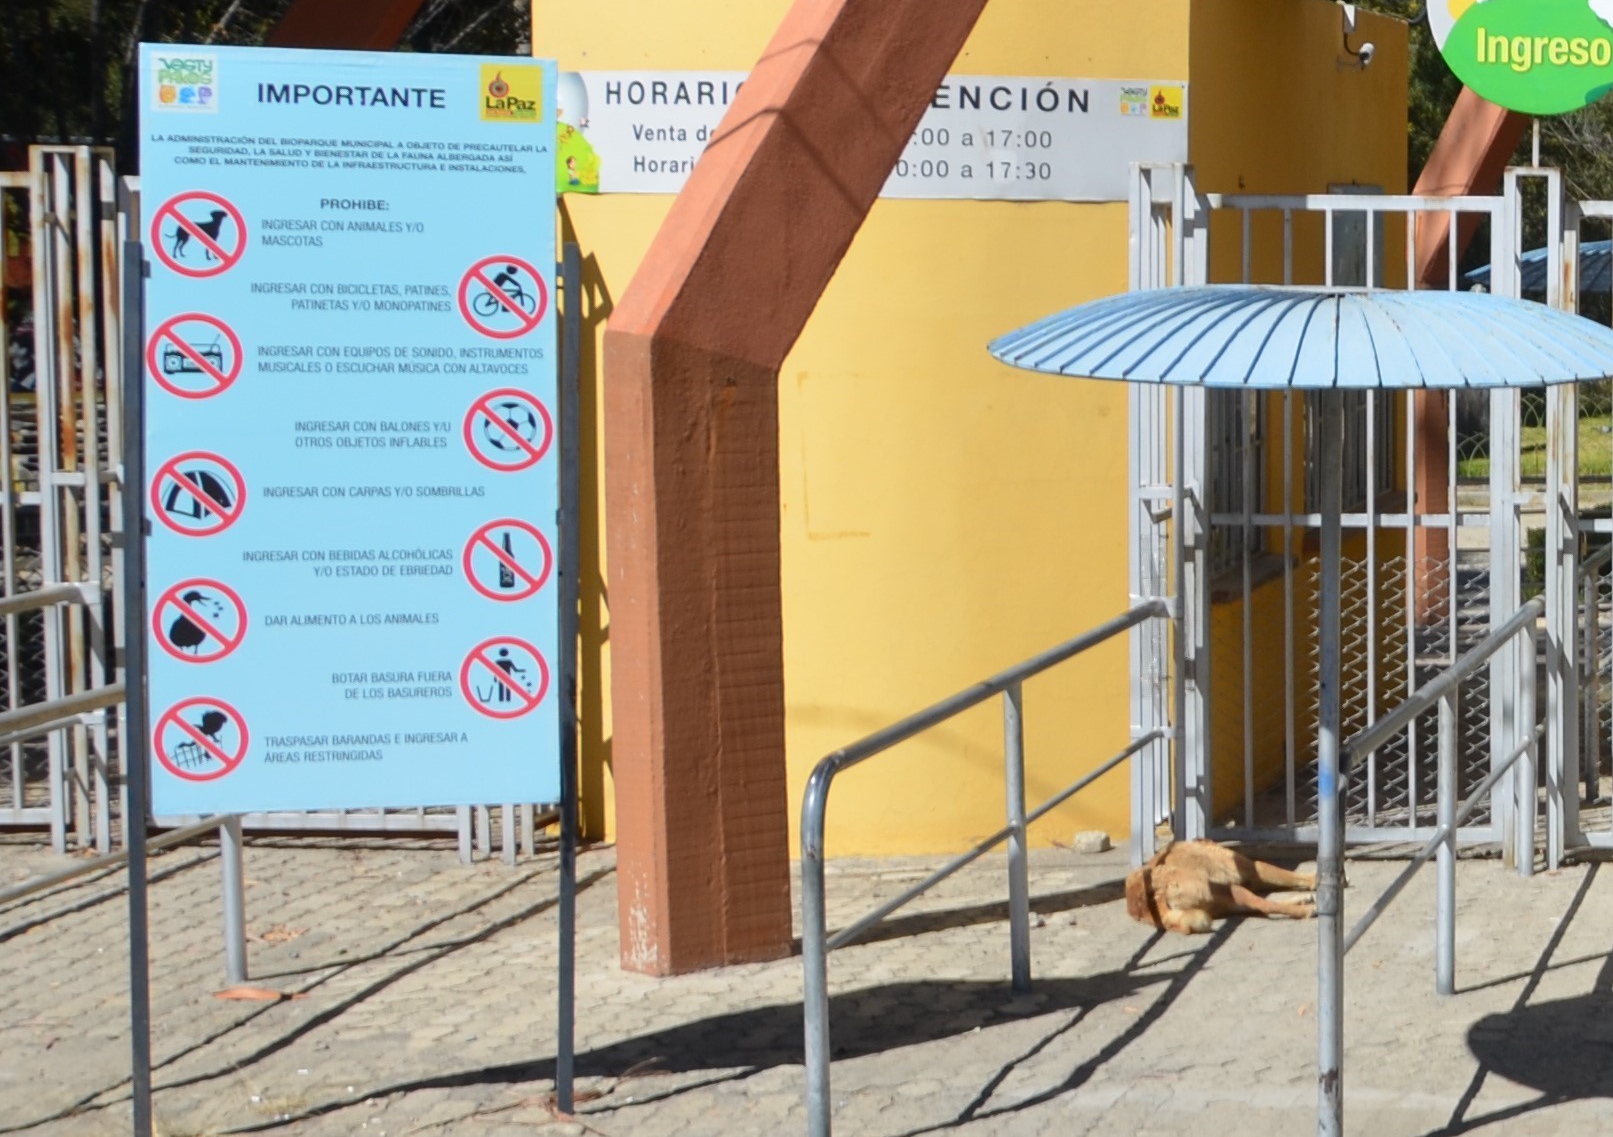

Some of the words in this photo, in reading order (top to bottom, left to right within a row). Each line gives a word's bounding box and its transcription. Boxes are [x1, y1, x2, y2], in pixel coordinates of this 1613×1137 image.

[1476, 26, 1612, 73] Ingreso
[258, 83, 445, 108] IMPORTANTE
[606, 80, 745, 105] HORARI
[931, 81, 1089, 113] ENCIÓN
[632, 124, 687, 142] Venta
[696, 124, 715, 142] d
[961, 132, 974, 147] a
[986, 129, 1052, 149] 17:00
[633, 155, 694, 173] Horari
[896, 159, 950, 178] 0:00
[961, 163, 973, 178] a
[986, 161, 1052, 180] 17:30
[320, 199, 389, 211] PROHIBE:
[262, 219, 317, 232] INGRESAR
[321, 220, 344, 232] CON
[347, 220, 402, 233] ANIMALES
[406, 222, 424, 234] Y/O
[262, 235, 323, 247] MASCOTAS
[251, 282, 307, 295] INGRESAR
[310, 283, 334, 295] CON
[291, 298, 349, 311] PATINETAS
[352, 299, 370, 312] Y/O
[374, 300, 451, 313] MONOPATINES
[258, 345, 313, 358] INGRESAR
[316, 346, 340, 358] CON
[344, 346, 391, 358] EQUIPOS
[394, 346, 408, 358] DE
[460, 347, 543, 359] INSTRUMENTOS
[258, 361, 321, 374] MUSICALES
[325, 362, 333, 374] O
[336, 362, 395, 374] ESCUCHAR
[443, 362, 466, 374] CON
[469, 362, 528, 375] ALTAVOCES
[295, 421, 350, 433] INGRESAR
[353, 421, 377, 433] CON
[380, 421, 430, 433] BALONES
[295, 436, 332, 448] OTROS
[336, 436, 386, 448] OBJETOS
[389, 436, 447, 448] INFLABLES
[263, 486, 318, 498] INGRESAR
[322, 486, 345, 498] CON
[349, 486, 391, 498] CARPAS
[395, 485, 413, 498] Y/O
[416, 485, 485, 497] SOMBRILLAS
[243, 550, 298, 562] INGRESAR
[302, 550, 325, 562] CON
[329, 549, 375, 562] BEBIDAS
[314, 565, 332, 578] Y/O
[336, 565, 378, 577] ESTADO
[382, 565, 396, 577] DE
[400, 564, 453, 577] EBRIEDAD
[265, 614, 287, 626] DAR
[291, 613, 346, 626] ALIMENTO
[349, 613, 356, 625] A
[360, 613, 381, 625] LOS
[384, 612, 439, 625] ANIMALES
[332, 671, 367, 684] BOTAR
[371, 671, 414, 683] BASURA
[418, 670, 452, 683] FUERA
[345, 687, 359, 699] DE
[363, 687, 384, 699] LOS
[387, 686, 452, 699] BASUREROS
[265, 734, 328, 747] TRASPASAR
[332, 733, 391, 746] BARANDAS
[394, 733, 400, 745] E
[404, 732, 458, 745] INGRESAR
[461, 732, 467, 744] A
[304, 749, 383, 763] RESTRINGIDAS
